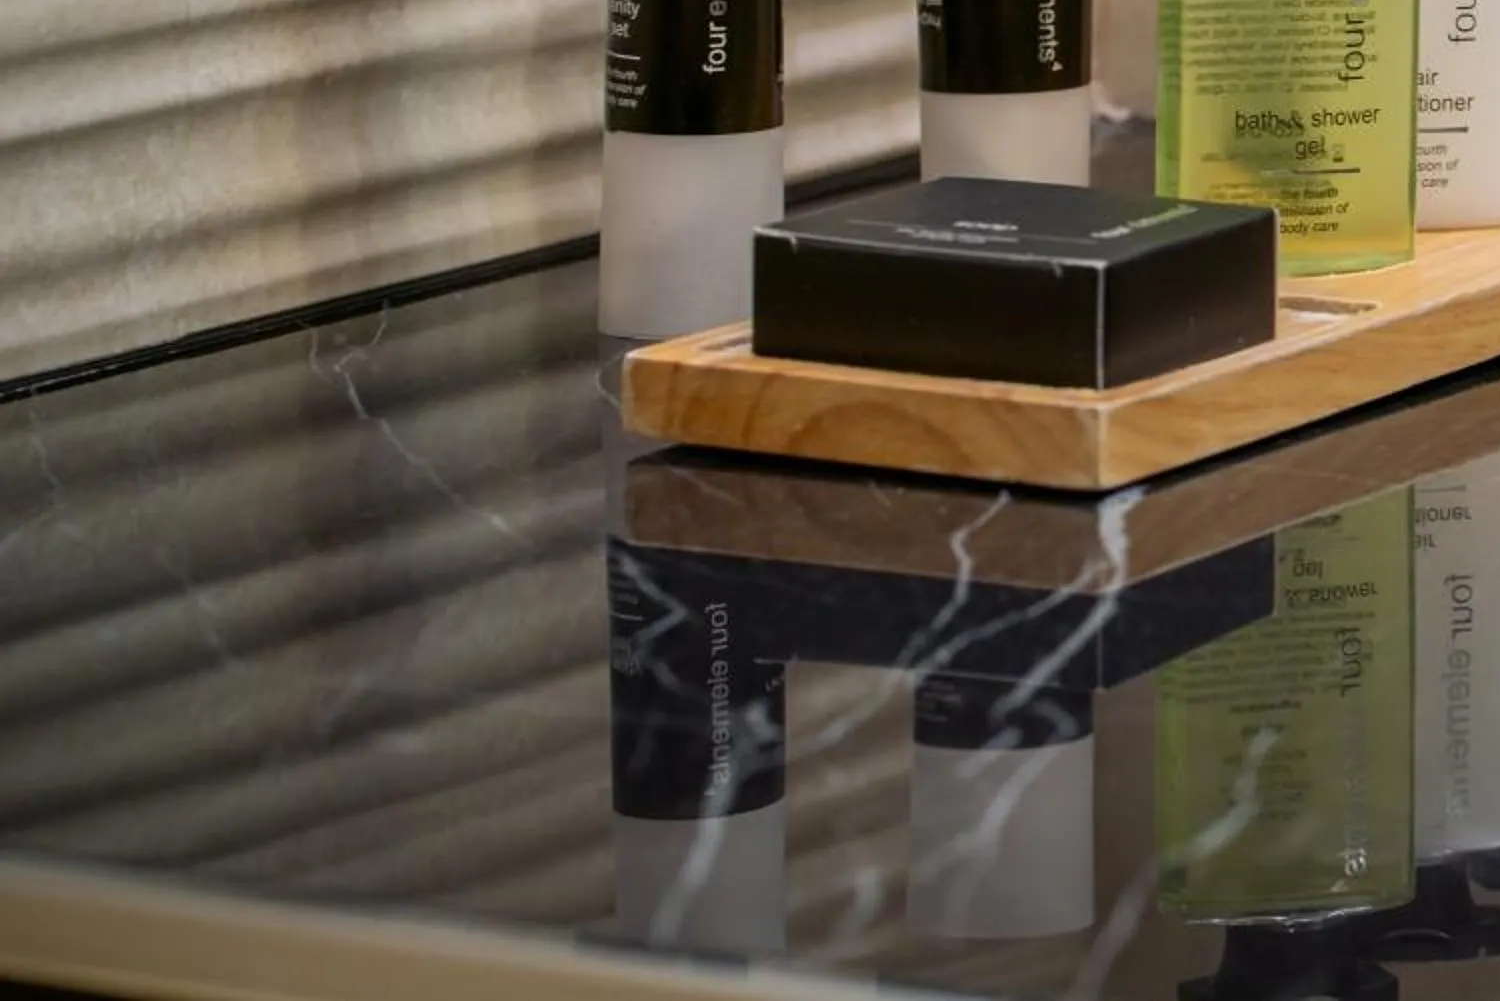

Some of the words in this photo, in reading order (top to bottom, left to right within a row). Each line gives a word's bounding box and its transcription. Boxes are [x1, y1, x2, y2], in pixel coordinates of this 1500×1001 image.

[702, 20, 728, 75] four
[1337, 12, 1365, 82] four
[1417, 68, 1440, 86] air
[1417, 93, 1476, 112] tioner
[1234, 110, 1279, 130] bath
[1311, 108, 1381, 128] shower
[1295, 135, 1326, 160] gel
[1336, 202, 1350, 215] of
